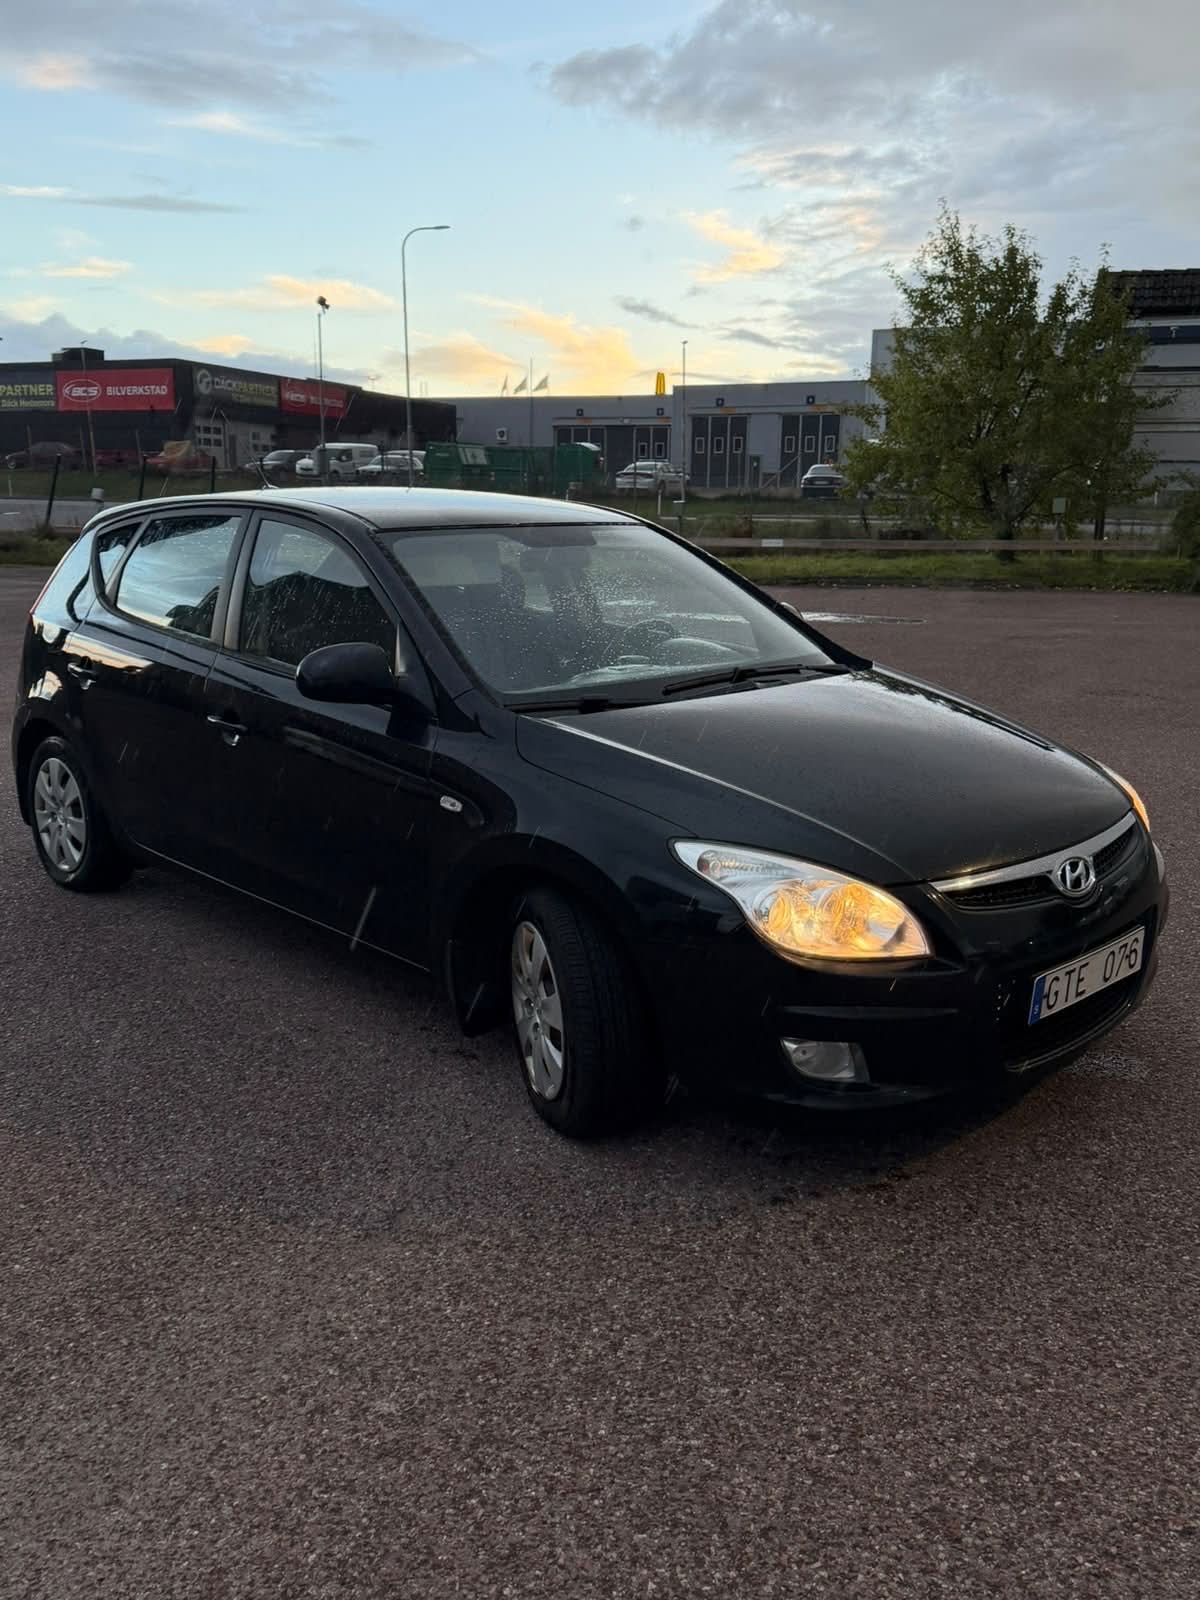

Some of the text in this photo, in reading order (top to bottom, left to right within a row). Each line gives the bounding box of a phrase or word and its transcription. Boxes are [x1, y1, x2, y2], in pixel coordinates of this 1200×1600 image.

[106, 385, 168, 396] BILVERKSTAD
[1046, 937, 1139, 1010] GTE 076
